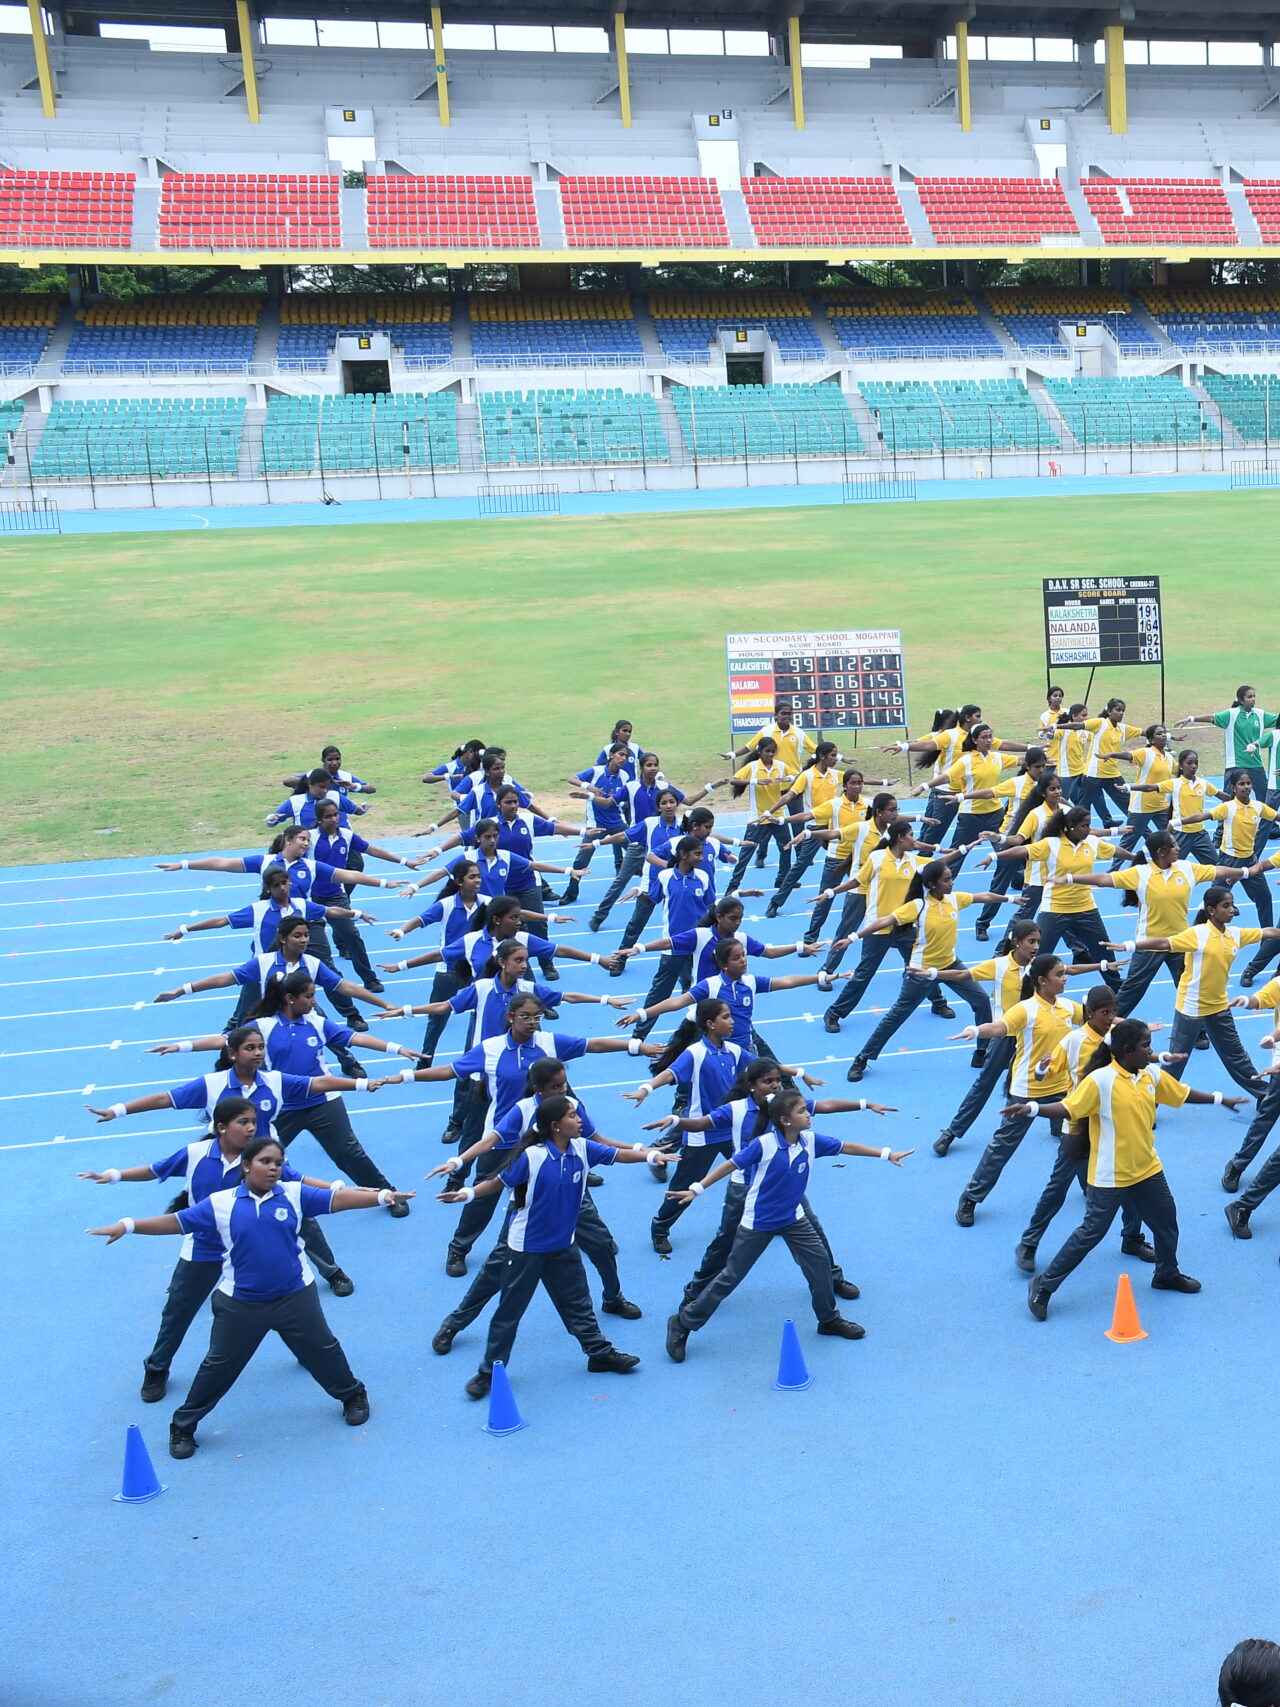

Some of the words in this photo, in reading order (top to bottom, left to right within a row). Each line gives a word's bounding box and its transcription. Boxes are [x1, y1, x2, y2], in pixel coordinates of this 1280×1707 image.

[1048, 579, 1069, 590] D.A.V.
[1070, 579, 1080, 589] SR
[1081, 578, 1098, 589] SEC.
[1049, 608, 1098, 619] KALAKSHETRA
[1139, 605, 1158, 618] 191
[1051, 622, 1097, 633] NALANDA
[1140, 620, 1159, 632] 164
[754, 635, 808, 643] SECONDARY
[855, 632, 899, 640] MOGAPPAIR
[1146, 634, 1159, 645] 92
[1052, 651, 1097, 662] TAKSHASHILA
[1141, 648, 1159, 661] 161
[731, 680, 760, 690] NALANDA
